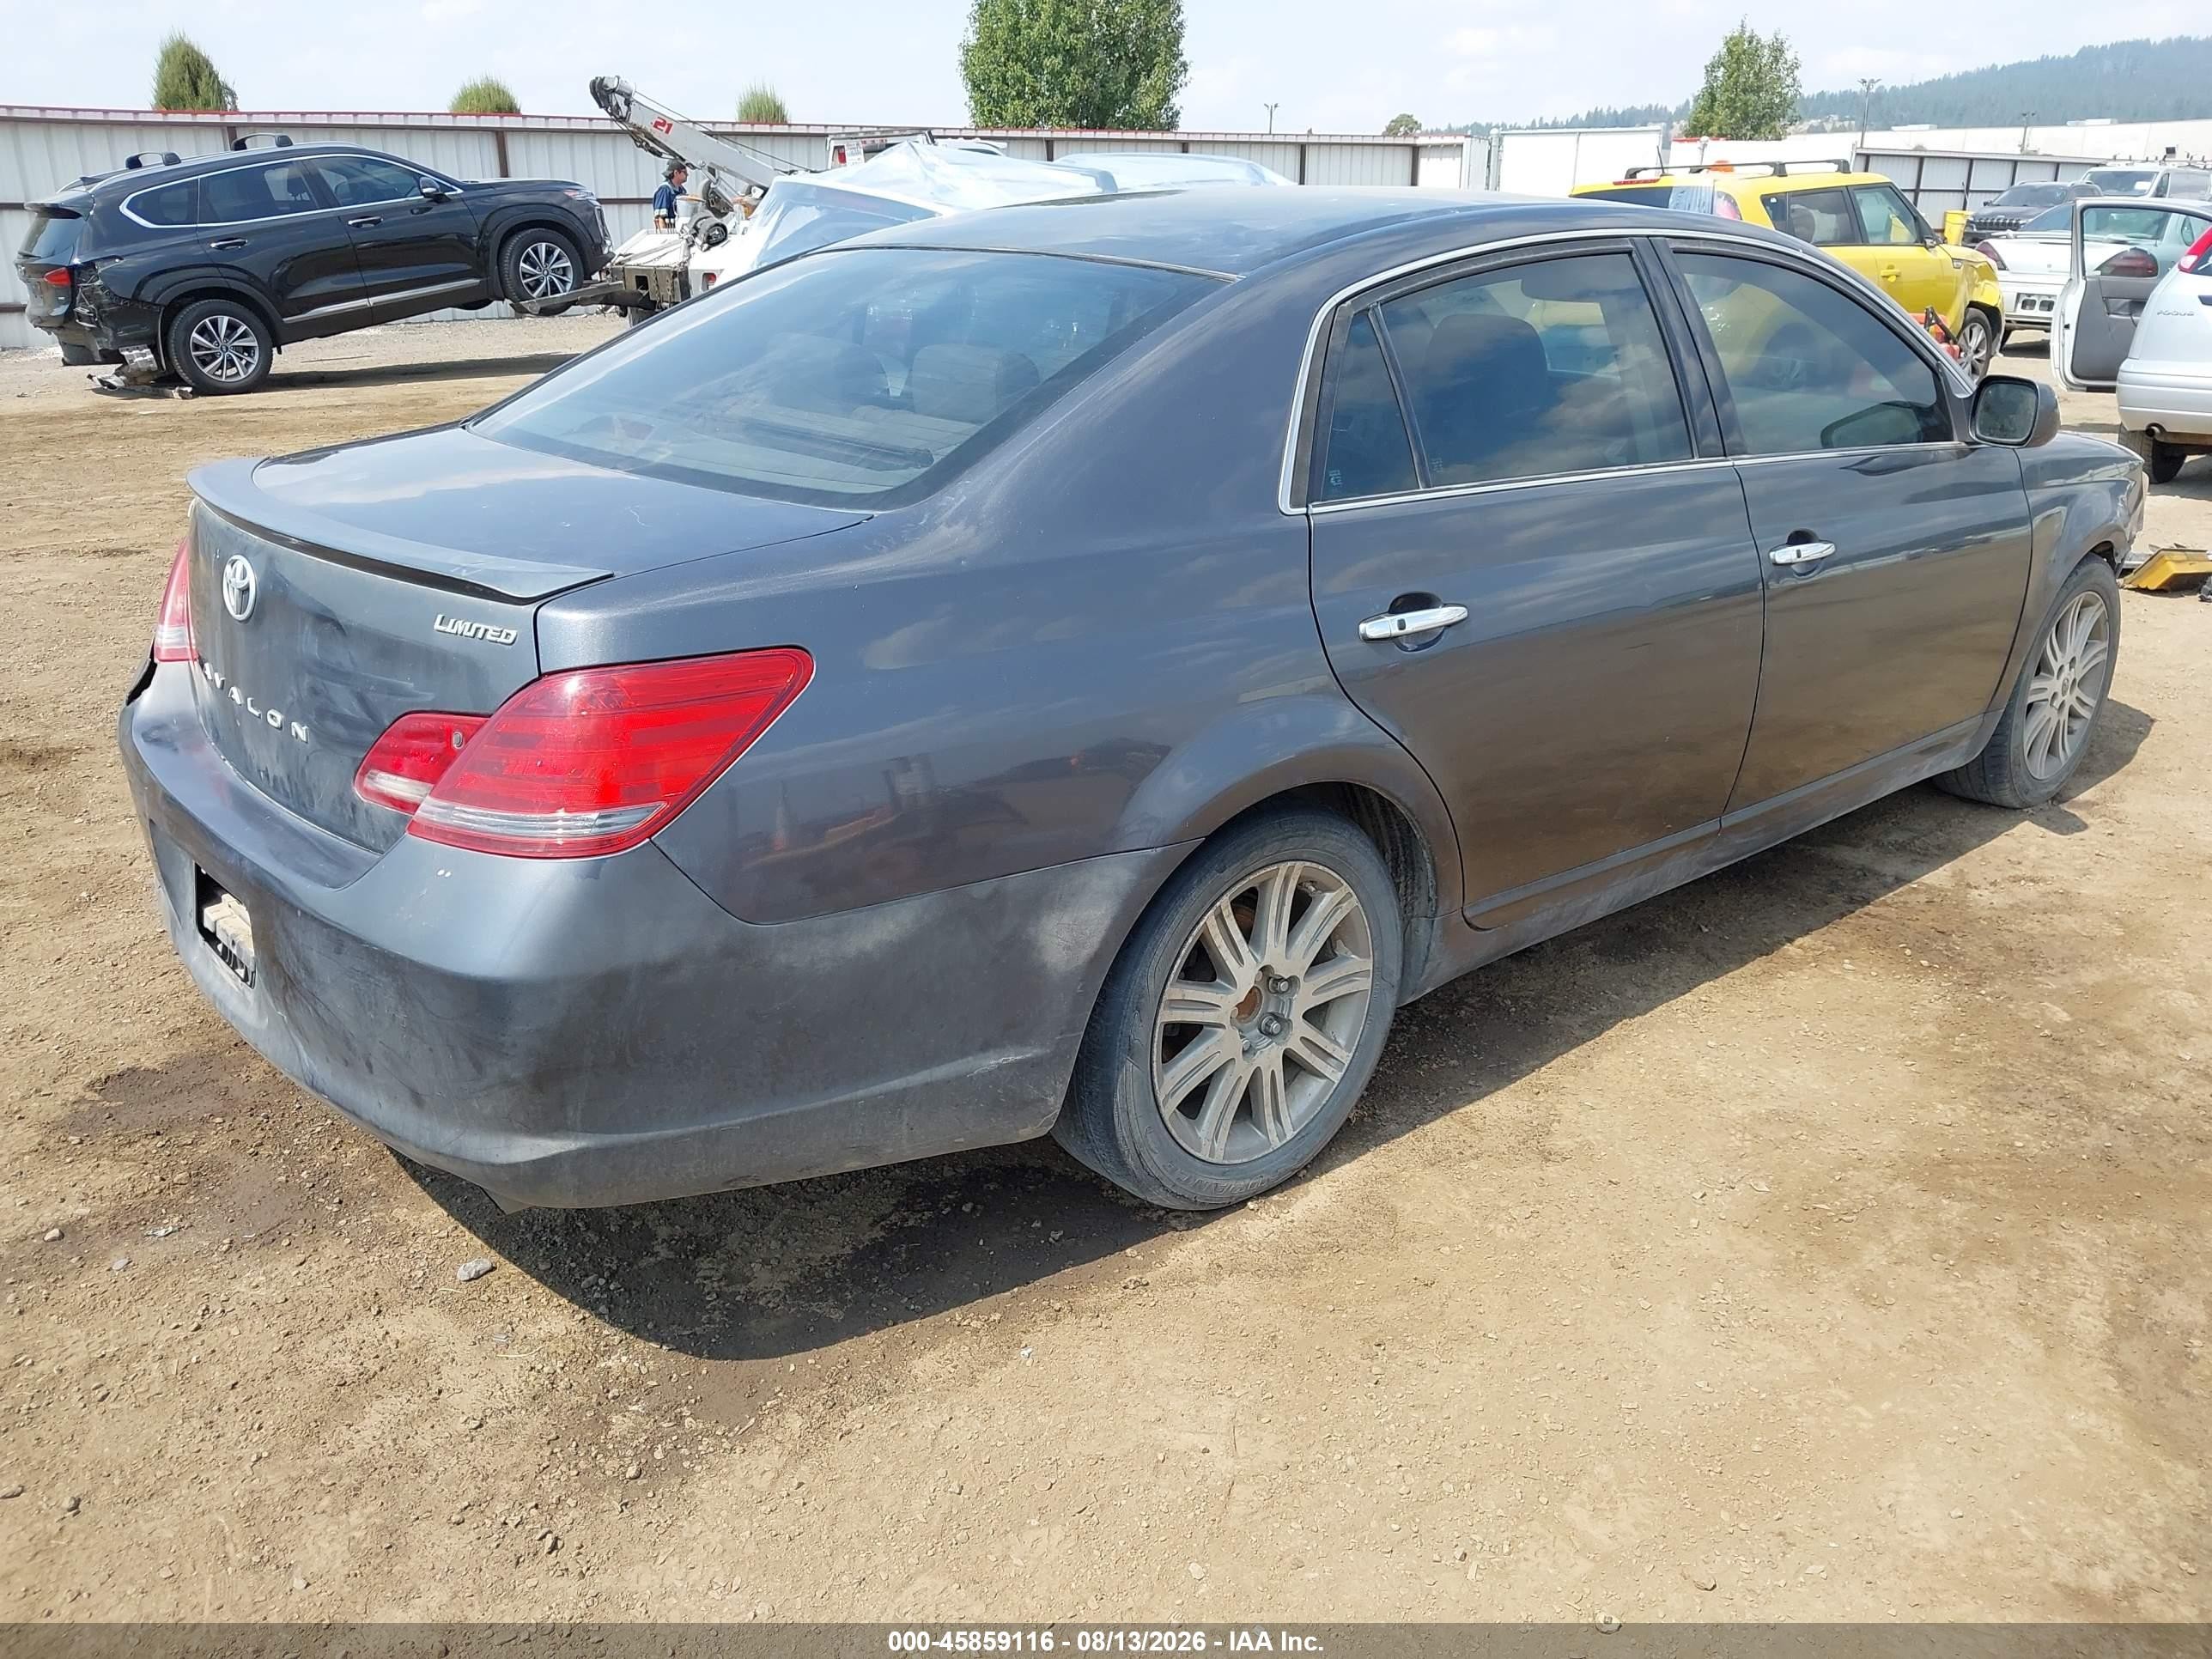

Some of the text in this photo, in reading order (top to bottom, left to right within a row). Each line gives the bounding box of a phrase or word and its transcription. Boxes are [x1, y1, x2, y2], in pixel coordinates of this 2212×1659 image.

[652, 115, 674, 136] 21
[433, 613, 519, 646] LIMITED
[203, 661, 310, 744] AVALON
